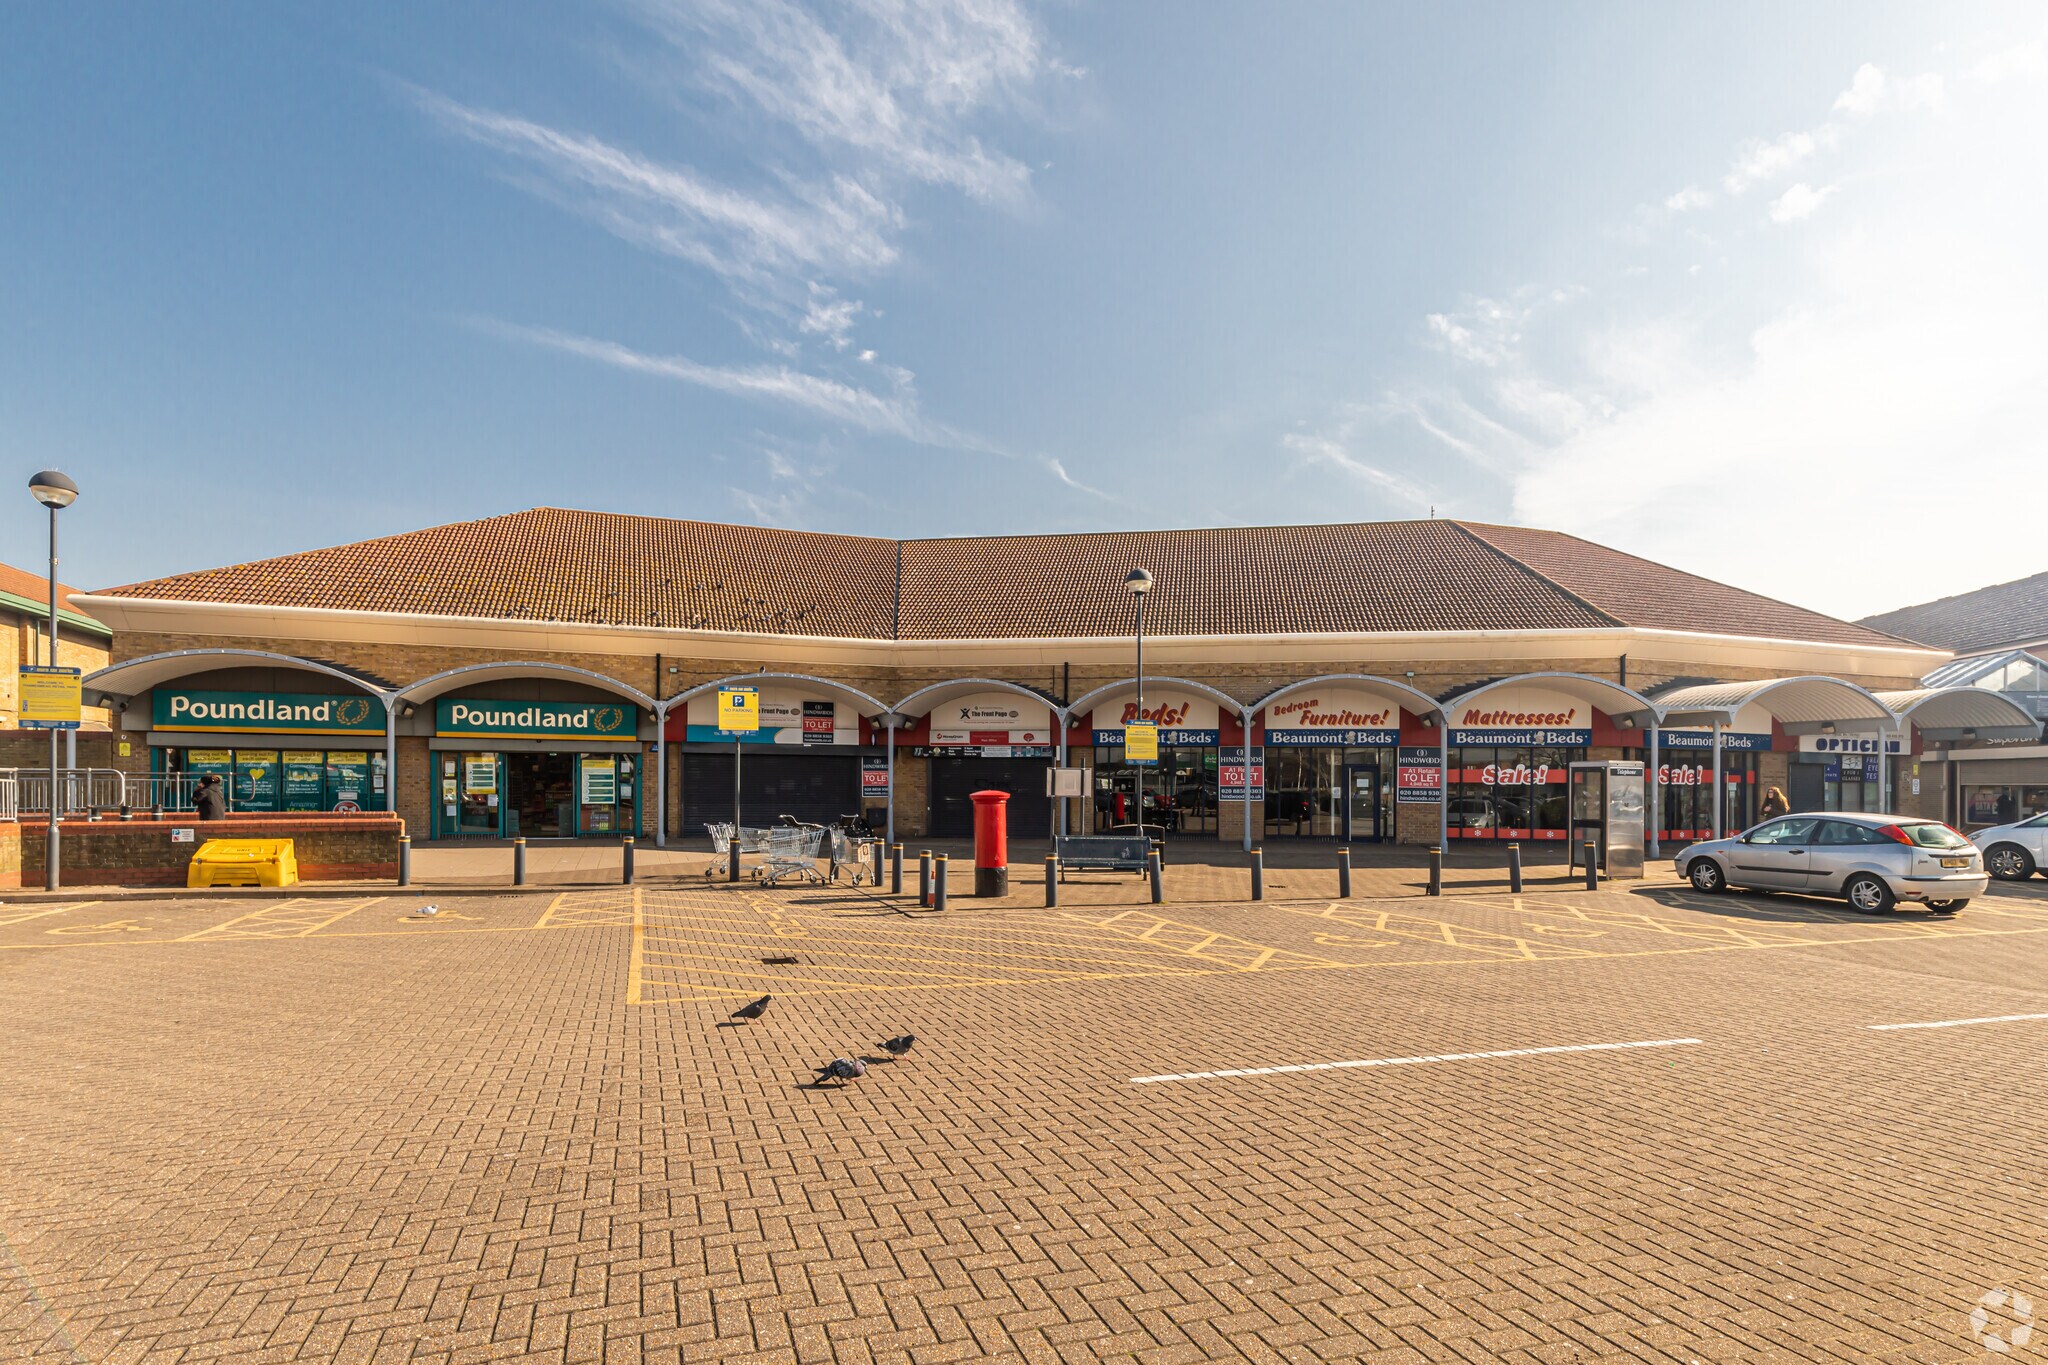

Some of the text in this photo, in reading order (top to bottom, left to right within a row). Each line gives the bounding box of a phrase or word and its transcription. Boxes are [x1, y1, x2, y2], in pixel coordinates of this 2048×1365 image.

[170, 696, 330, 722] Poundland
[452, 704, 588, 728] Poundland
[1274, 699, 1318, 716] Bedroom
[1300, 709, 1390, 726] Furniture!
[1462, 708, 1576, 727] Mattresses!
[1179, 732, 1212, 743] Beds
[1272, 732, 1392, 744] Beaumont Beds
[1456, 732, 1583, 744] Beaumont Beds
[1668, 733, 1752, 748] Beaumon Beds
[1421, 774, 1440, 782] LET
[1482, 764, 1548, 785] Sale!
[1659, 764, 1703, 785] Sale!
